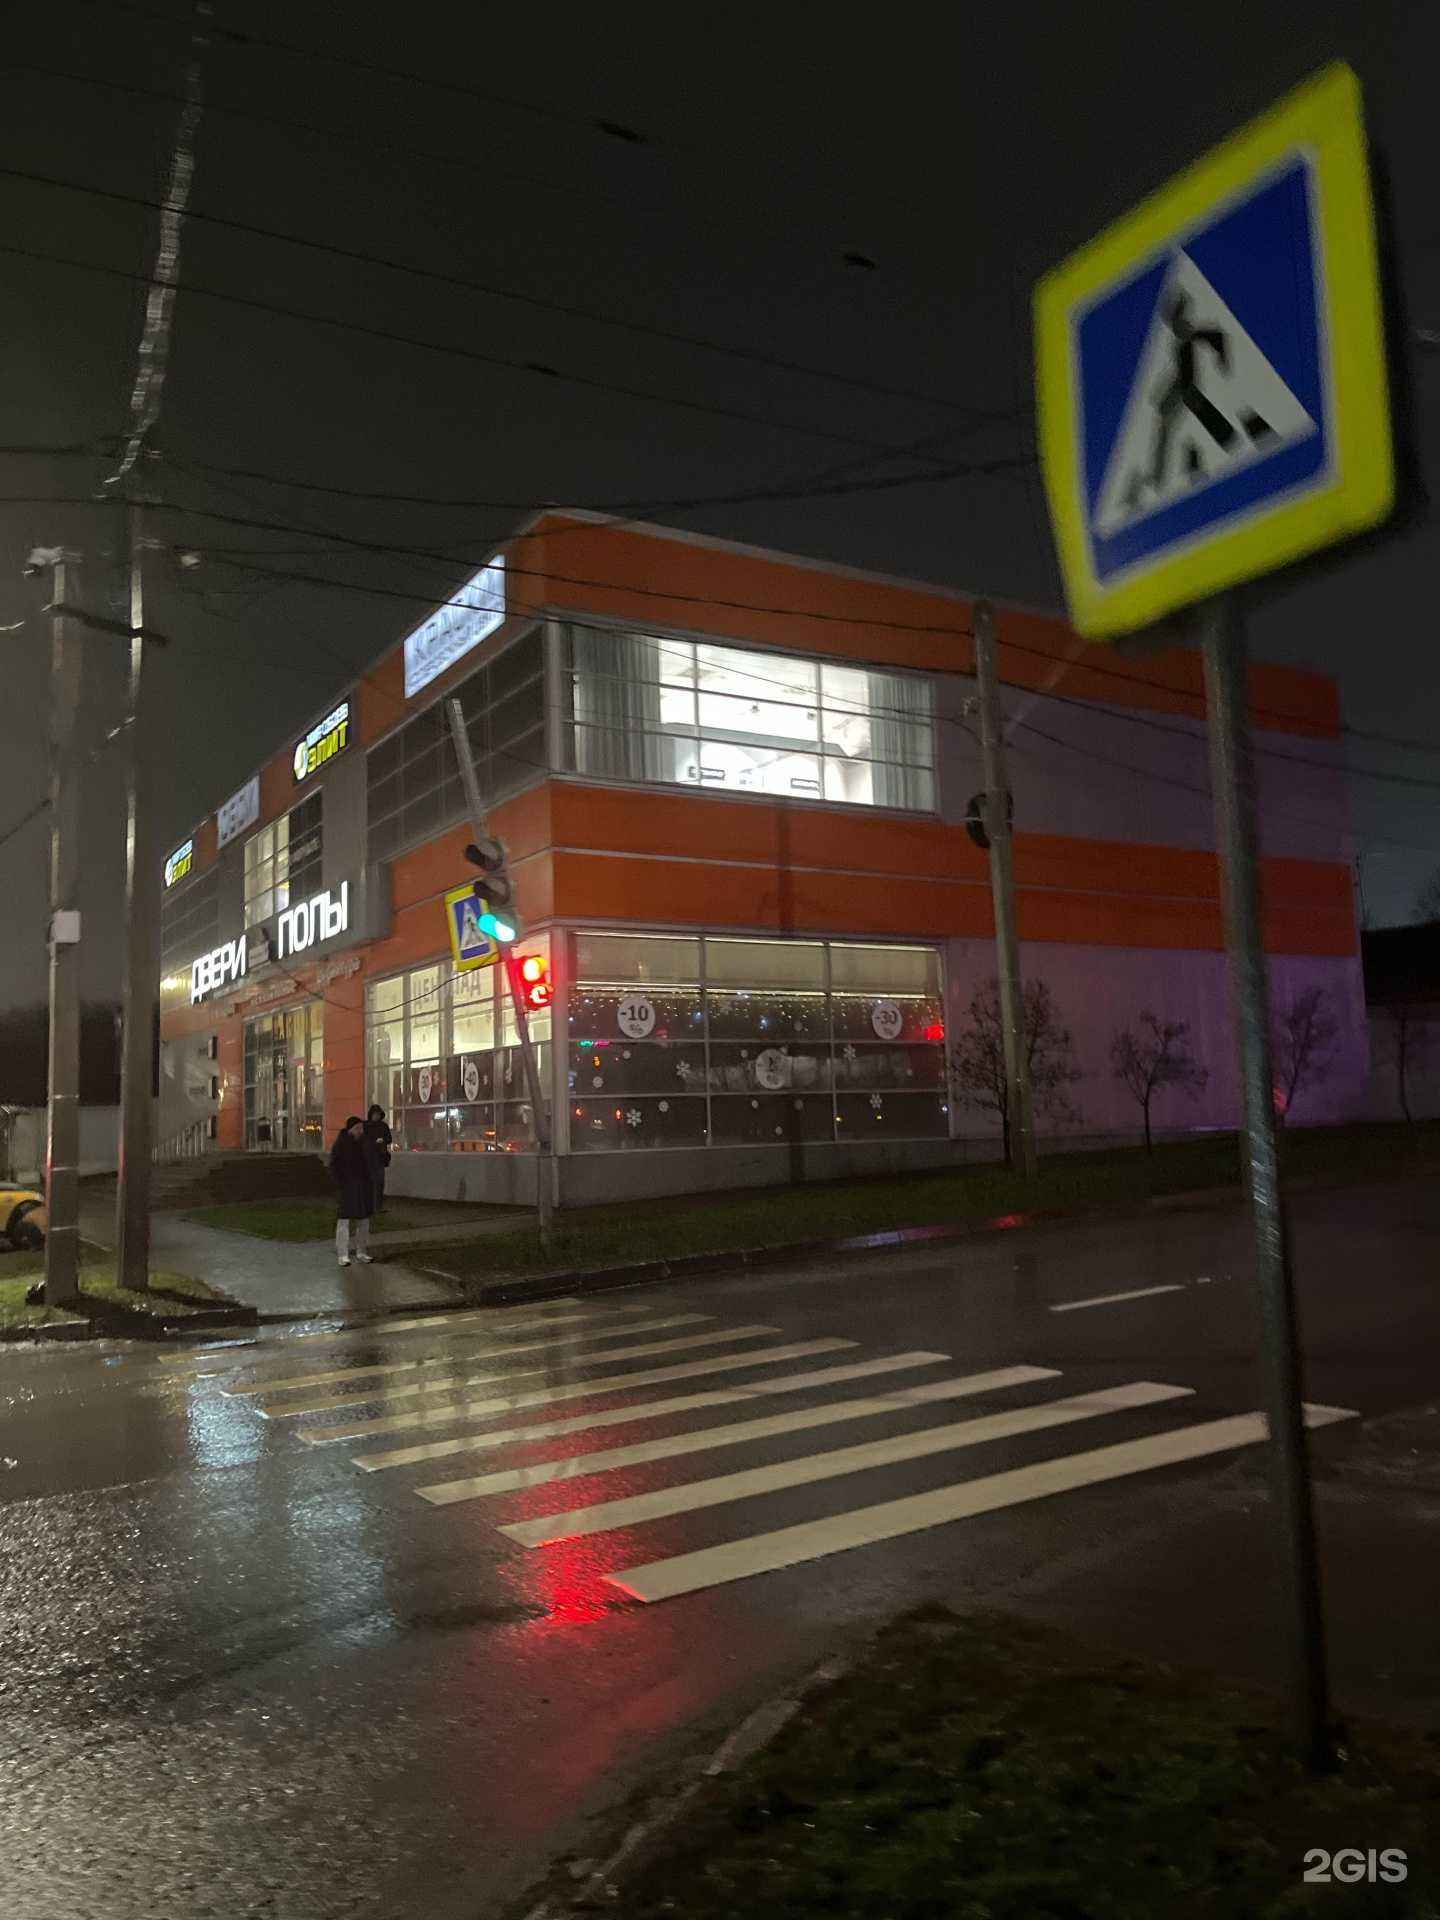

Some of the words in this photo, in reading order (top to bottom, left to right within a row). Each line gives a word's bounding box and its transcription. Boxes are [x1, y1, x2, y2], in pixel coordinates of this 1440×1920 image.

[191, 934, 247, 1006] ДВЕРИ
[278, 880, 349, 959] ПОЛЫ
[620, 1005, 649, 1021] -10
